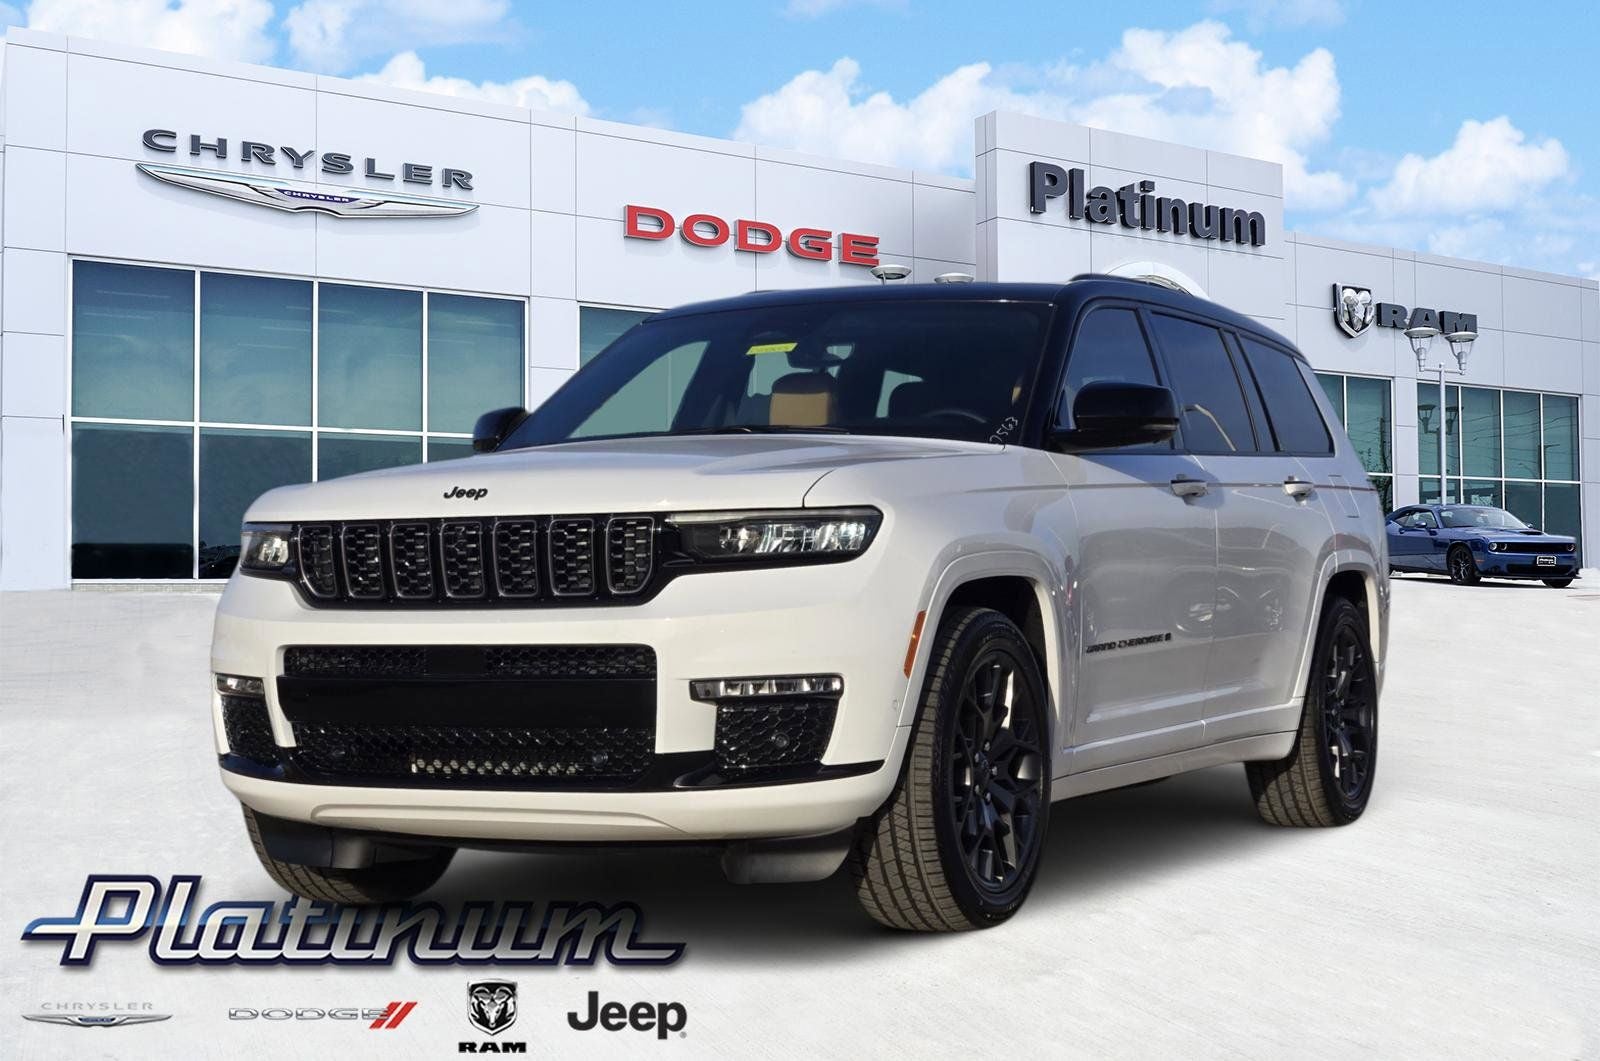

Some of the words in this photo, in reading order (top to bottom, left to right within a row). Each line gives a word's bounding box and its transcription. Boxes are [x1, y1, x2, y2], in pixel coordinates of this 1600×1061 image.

[142, 129, 474, 190] CHRYSLER
[283, 190, 350, 203] CHRYSLER
[1028, 160, 1267, 247] Platinum
[623, 204, 880, 267] DODGE
[1376, 302, 1478, 335] RAM
[443, 486, 489, 501] Jeep
